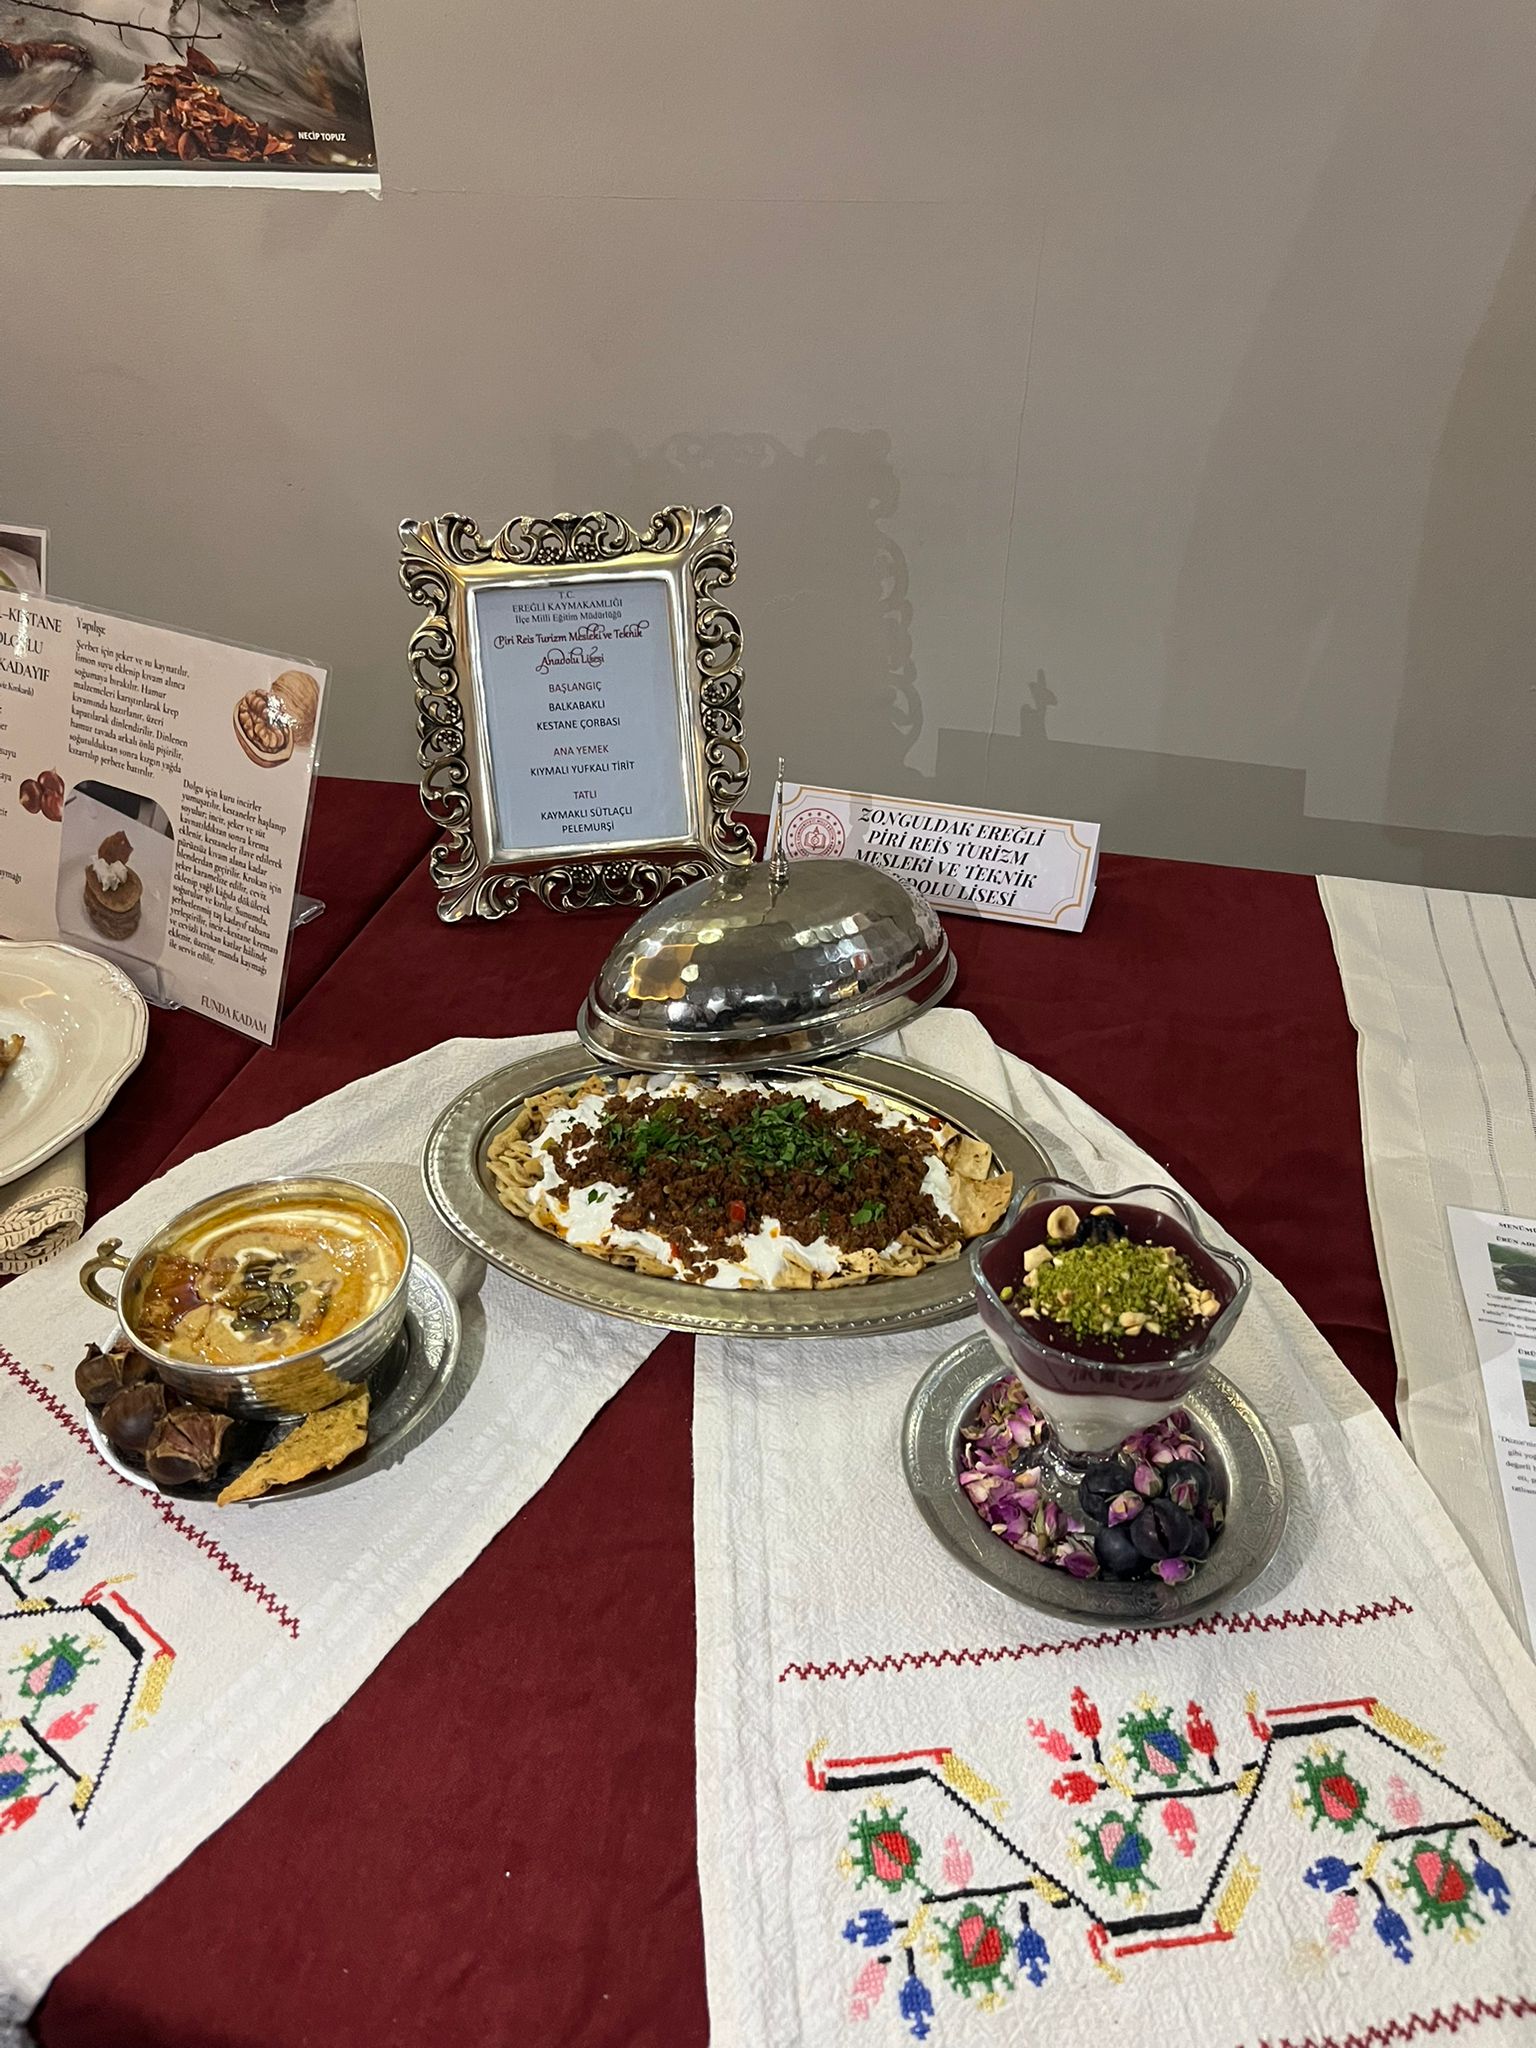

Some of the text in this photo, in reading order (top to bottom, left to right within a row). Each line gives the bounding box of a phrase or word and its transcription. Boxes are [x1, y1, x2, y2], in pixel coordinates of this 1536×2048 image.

[298, 131, 346, 141] NECİP TOPUZ
[512, 598, 622, 612] EREĞLİ KAYMAKAMLIĞI
[516, 610, 622, 624] İlçe Milli Eğitim Müdürlüğü
[494, 636, 514, 649] Piri
[517, 634, 534, 644] Reis
[536, 633, 566, 643] Turizm
[569, 623, 605, 641] Mesleki
[614, 620, 649, 638] Teknik
[76, 640, 98, 653] Şerbet
[101, 646, 113, 658] için
[115, 650, 134, 662] şeker
[536, 646, 604, 674] Anadolu Lisesi
[74, 668, 107, 685] soğumaya
[141, 684, 166, 699] Hamur
[75, 651, 185, 690] limon suyu eklenip kıvam alınca
[74, 681, 179, 719] malzemeleri karıştırılarak krep
[549, 681, 602, 692] BAŞLANGIÇ
[72, 692, 107, 710] kıvamında
[146, 714, 164, 726] üzeri
[549, 700, 605, 711] BALKABAKLI
[70, 718, 92, 732] hamur
[94, 728, 116, 739] tavada
[118, 733, 137, 746] arkalı
[139, 738, 154, 750] önlü
[72, 704, 108, 724] kapatılarak
[156, 730, 188, 747] Dinlenen
[537, 718, 621, 731] KESTANE ÇORBASI
[68, 744, 98, 764] kızartılıp
[100, 756, 124, 770] şerbete
[70, 734, 181, 774] soğutulduktan sonra kızgın yağda
[553, 745, 609, 756] ANA YEMEK
[530, 760, 635, 776] KIYMALI YUFKALI TİRİT
[184, 779, 261, 812] Dolgu için kuru incirler
[573, 791, 597, 800] TATLI
[222, 803, 255, 822] kestaneler
[258, 814, 286, 835] haşlanıp
[227, 819, 244, 831] şeker
[255, 829, 265, 838] süt
[541, 806, 632, 821] KAYMAKLI SÜTLAÇLI
[562, 822, 614, 833] PELEMURŞİ
[858, 808, 1047, 847] ZONGULDAK EREĞLİ
[180, 812, 268, 852] kaynatıldıktan sonra krema
[867, 828, 1030, 866] PİRİ REİS TURİZM
[177, 838, 267, 876] pürüzsüz kıvam alana kadar
[204, 832, 237, 853] kestaneler
[239, 846, 254, 859] ilave
[256, 852, 282, 869] edilerek
[175, 860, 192, 872] şeker
[194, 864, 227, 885] karamelize
[249, 889, 266, 900] ceviz
[176, 847, 212, 868] blenderdan
[243, 872, 267, 888] Krokan
[269, 882, 281, 894] için
[855, 849, 1038, 889] MESLEKİ VE TEKNİK
[173, 885, 203, 901] soğutulur
[174, 870, 197, 889] eklenip
[198, 882, 214, 895] yağlı
[237, 894, 270, 914] dökülerek
[957, 885, 1018, 908] LİSESİ
[170, 918, 176, 926] ve
[178, 920, 198, 934] cevizli
[200, 926, 221, 943] krokan
[223, 936, 241, 952] katlar
[213, 911, 222, 922] taş
[224, 912, 247, 931] kadayıf
[248, 921, 270, 939] tabana
[178, 945, 195, 956] servis
[194, 937, 216, 954] üzerine
[218, 950, 238, 963] manda
[240, 954, 266, 976] kaymağı
[201, 995, 266, 1034] FUNDA KADAM
